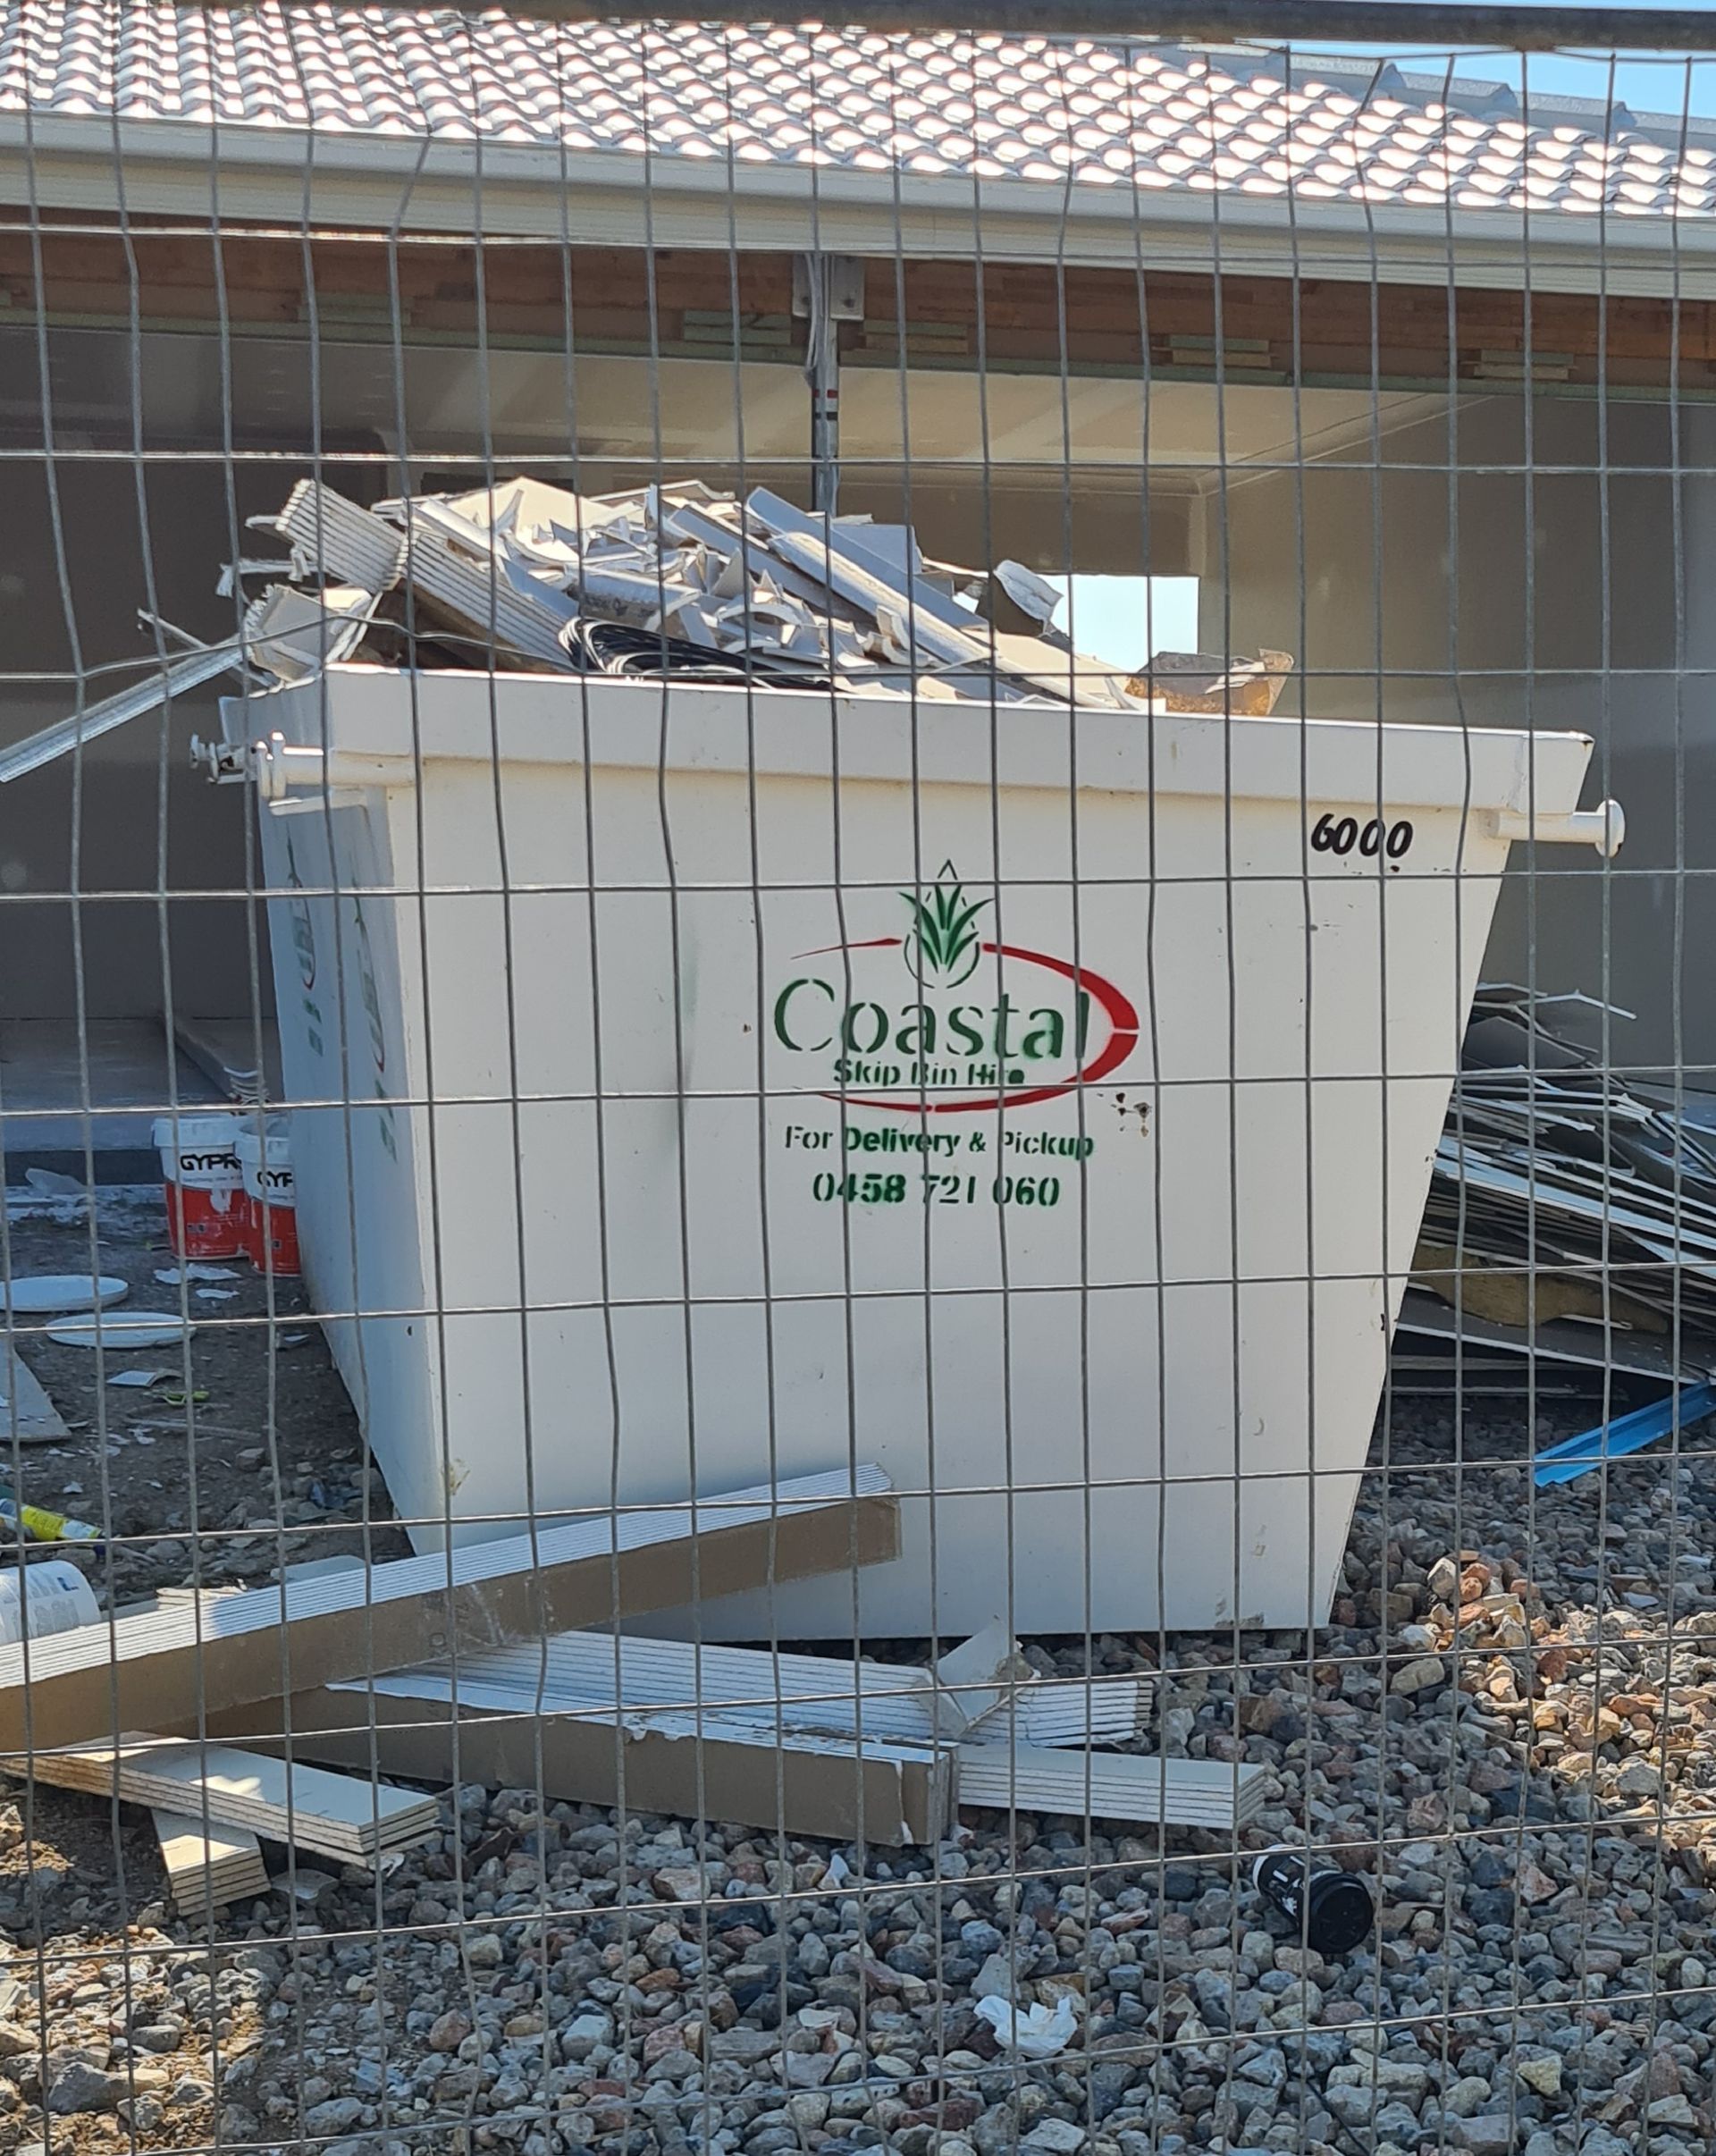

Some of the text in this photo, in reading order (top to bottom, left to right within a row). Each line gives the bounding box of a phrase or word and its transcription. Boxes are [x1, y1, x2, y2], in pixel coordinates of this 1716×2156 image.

[1311, 813, 1413, 858] 6000
[774, 979, 1089, 1058] Coastal
[833, 1058, 901, 1087] Skip
[911, 1061, 957, 1085] Bin
[786, 1126, 1094, 1161] For Delivery & Pickup
[812, 1173, 1059, 1207] 0458 721 060
